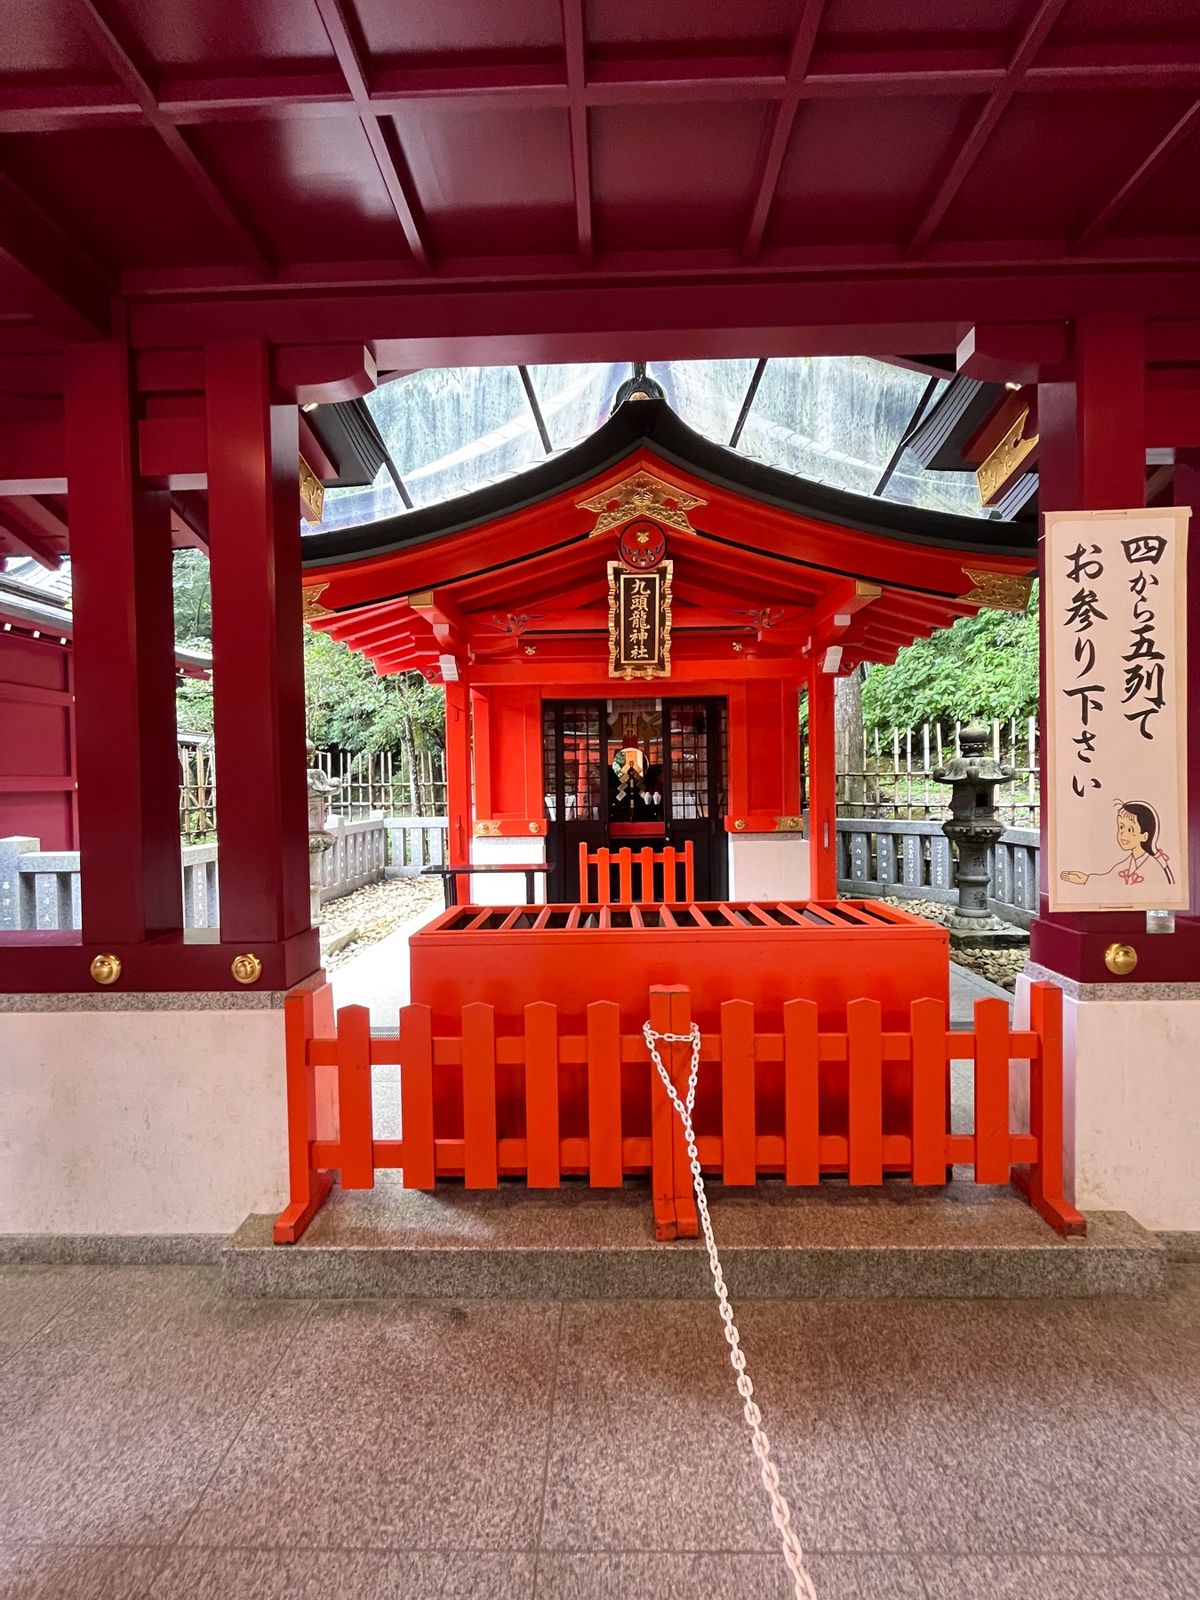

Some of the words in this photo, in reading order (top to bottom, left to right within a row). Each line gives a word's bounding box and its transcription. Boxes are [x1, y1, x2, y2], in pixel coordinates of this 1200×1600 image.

[628, 578, 651, 660] 九頭龍神社
[1063, 542, 1108, 797] お参り下さい
